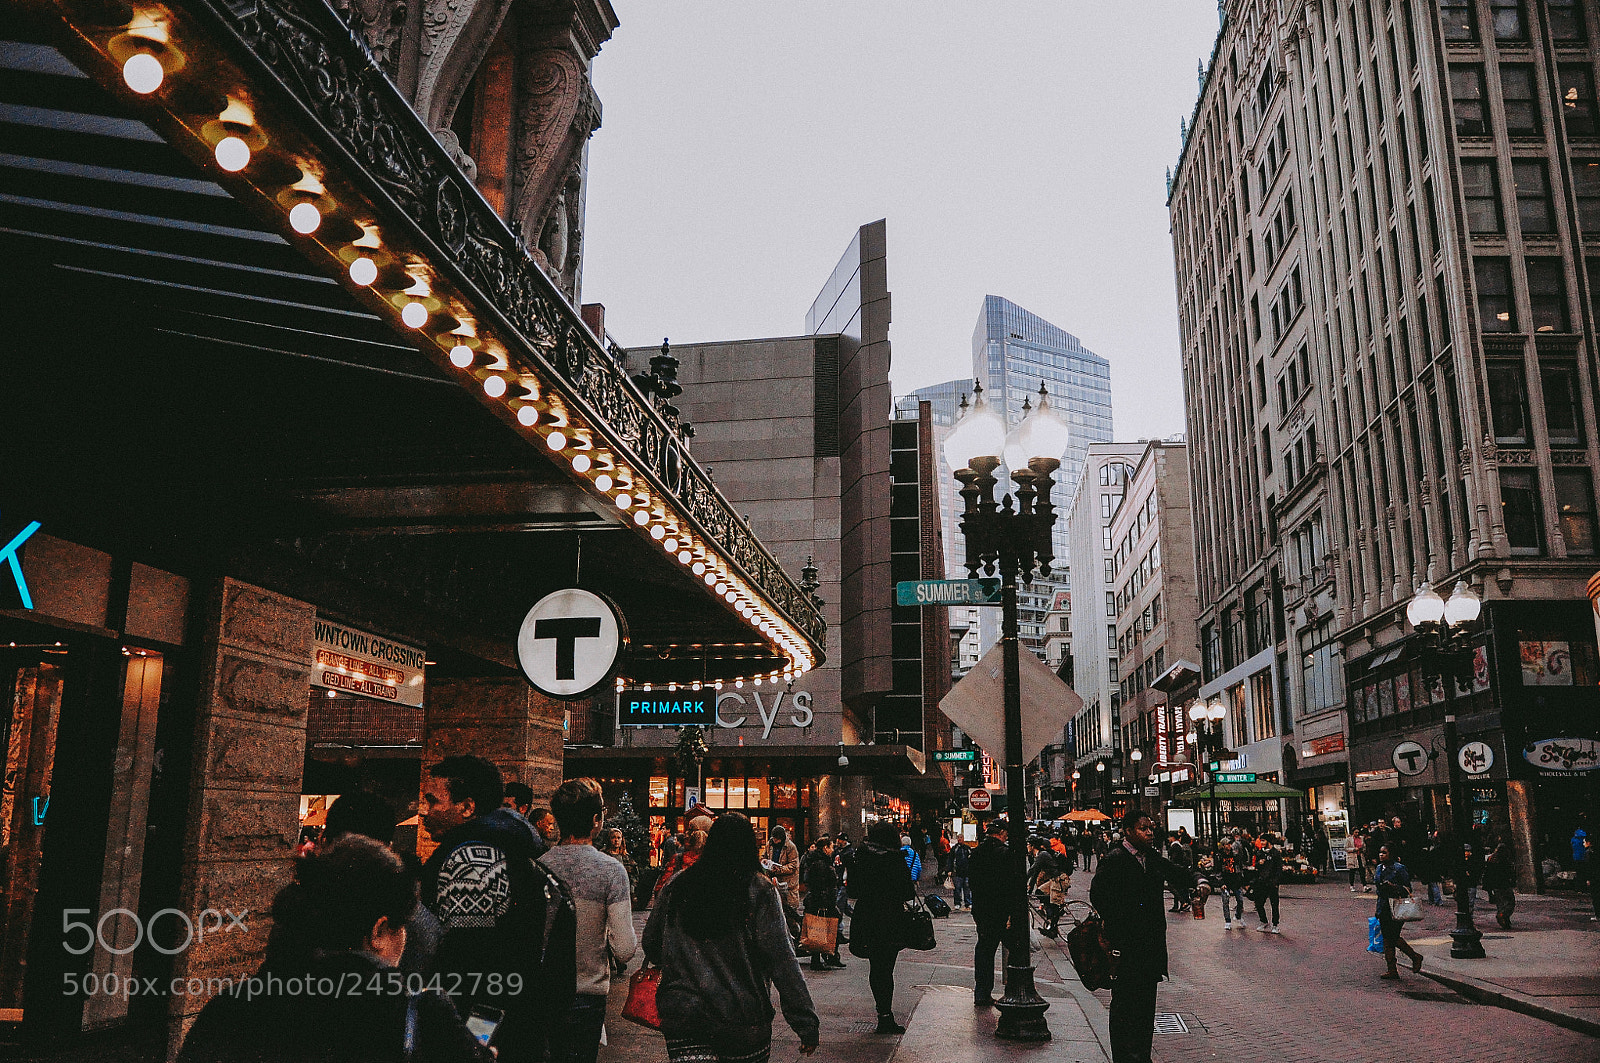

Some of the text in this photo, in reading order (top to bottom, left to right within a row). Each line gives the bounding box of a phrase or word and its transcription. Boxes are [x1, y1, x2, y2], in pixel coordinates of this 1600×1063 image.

[917, 583, 970, 602] SUMMER
[370, 639, 423, 670] CROSSING
[534, 616, 602, 681] T
[319, 651, 349, 669] ORANGE
[349, 659, 363, 673] LINE
[368, 664, 380, 678] ALL
[382, 668, 403, 683] TRAINS
[325, 673, 340, 686] RED
[340, 676, 356, 690] LINE
[360, 681, 373, 693] ALL
[374, 684, 396, 699] TRAINS
[630, 701, 705, 714] PRIMARK
[717, 691, 813, 740] cys
[1157, 705, 1168, 767] LIBERTY TRAVEL
[1398, 749, 1421, 771] T
[1226, 774, 1248, 782] WINTER
